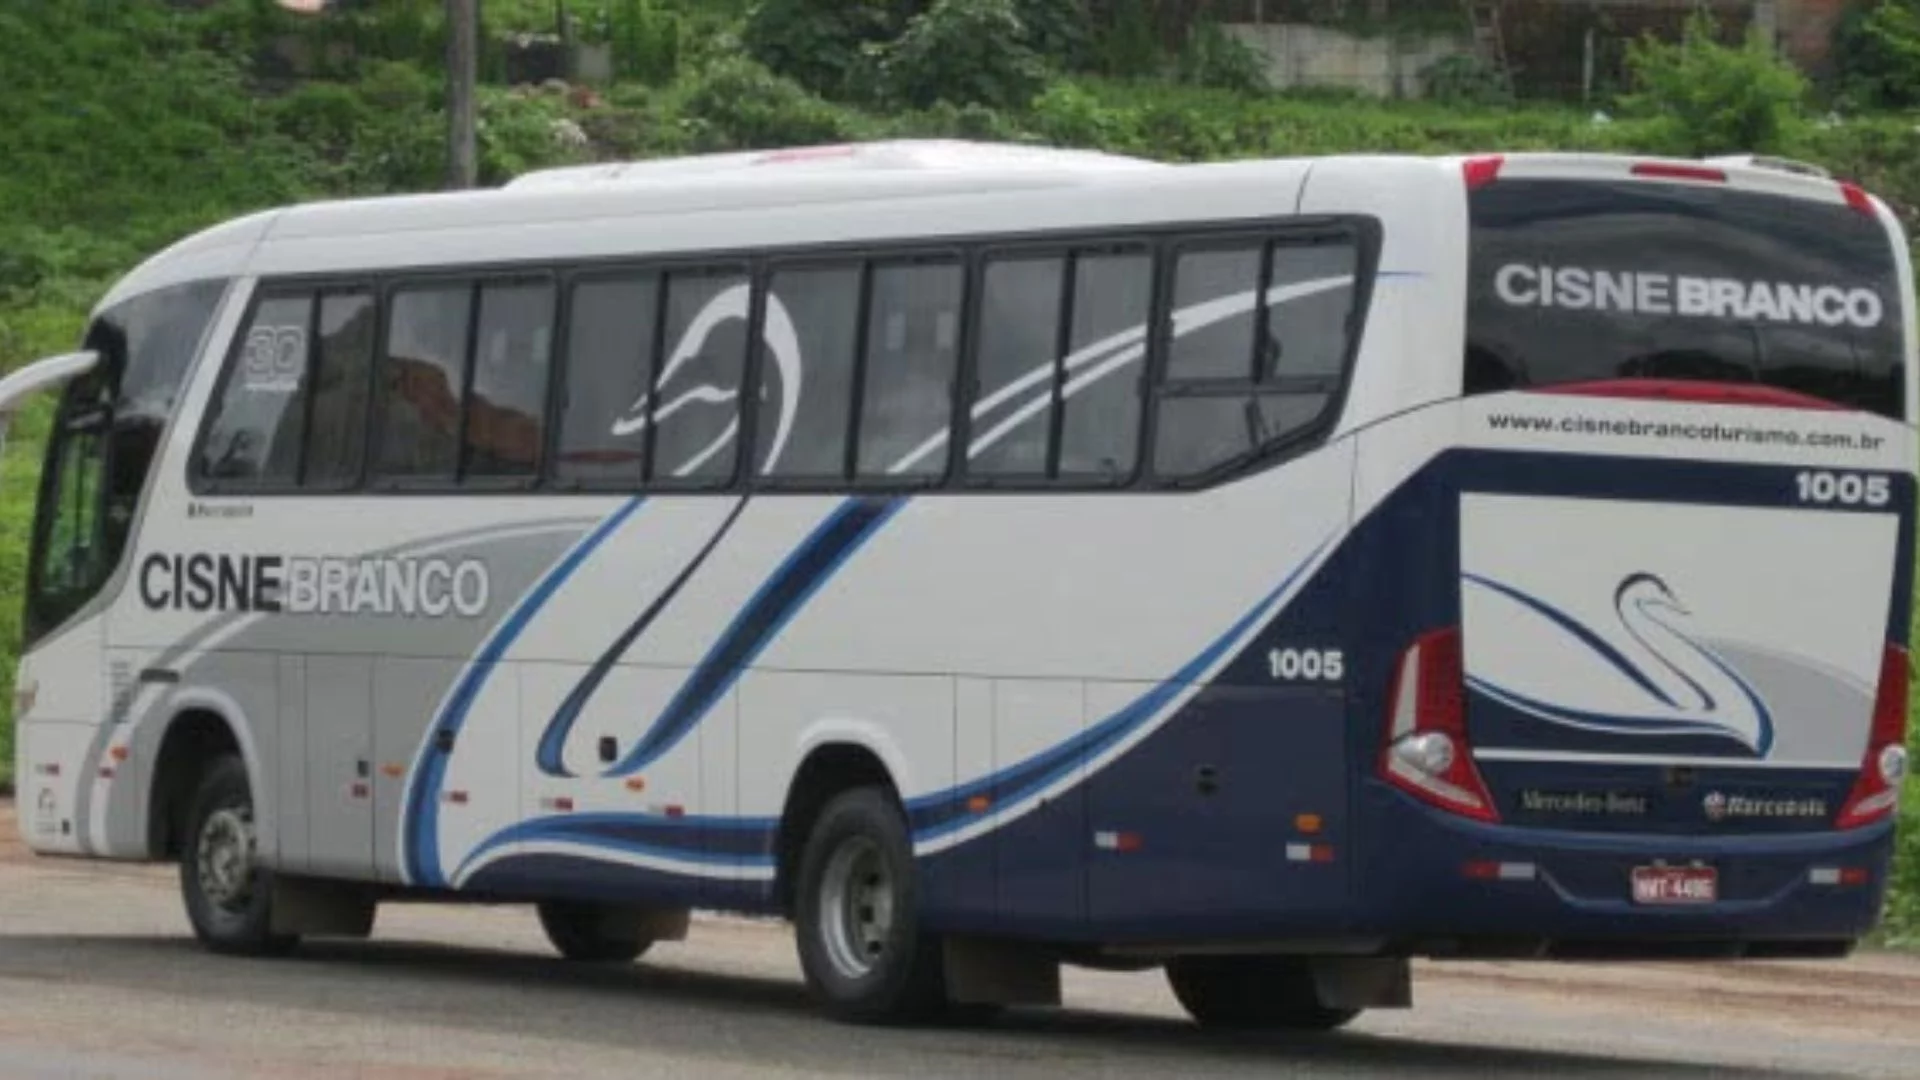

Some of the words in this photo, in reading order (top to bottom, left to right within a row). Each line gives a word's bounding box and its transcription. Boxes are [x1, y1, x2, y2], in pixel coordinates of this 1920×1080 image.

[1494, 263, 1671, 314] CISNE
[1676, 275, 1883, 328] BRANCO
[1487, 411, 1885, 450] www.cisnebrancoturismo.com.br
[1796, 471, 1890, 507] 1005
[139, 553, 282, 612] CISNE
[288, 556, 490, 616] BRANCO
[1268, 647, 1344, 680] 1005
